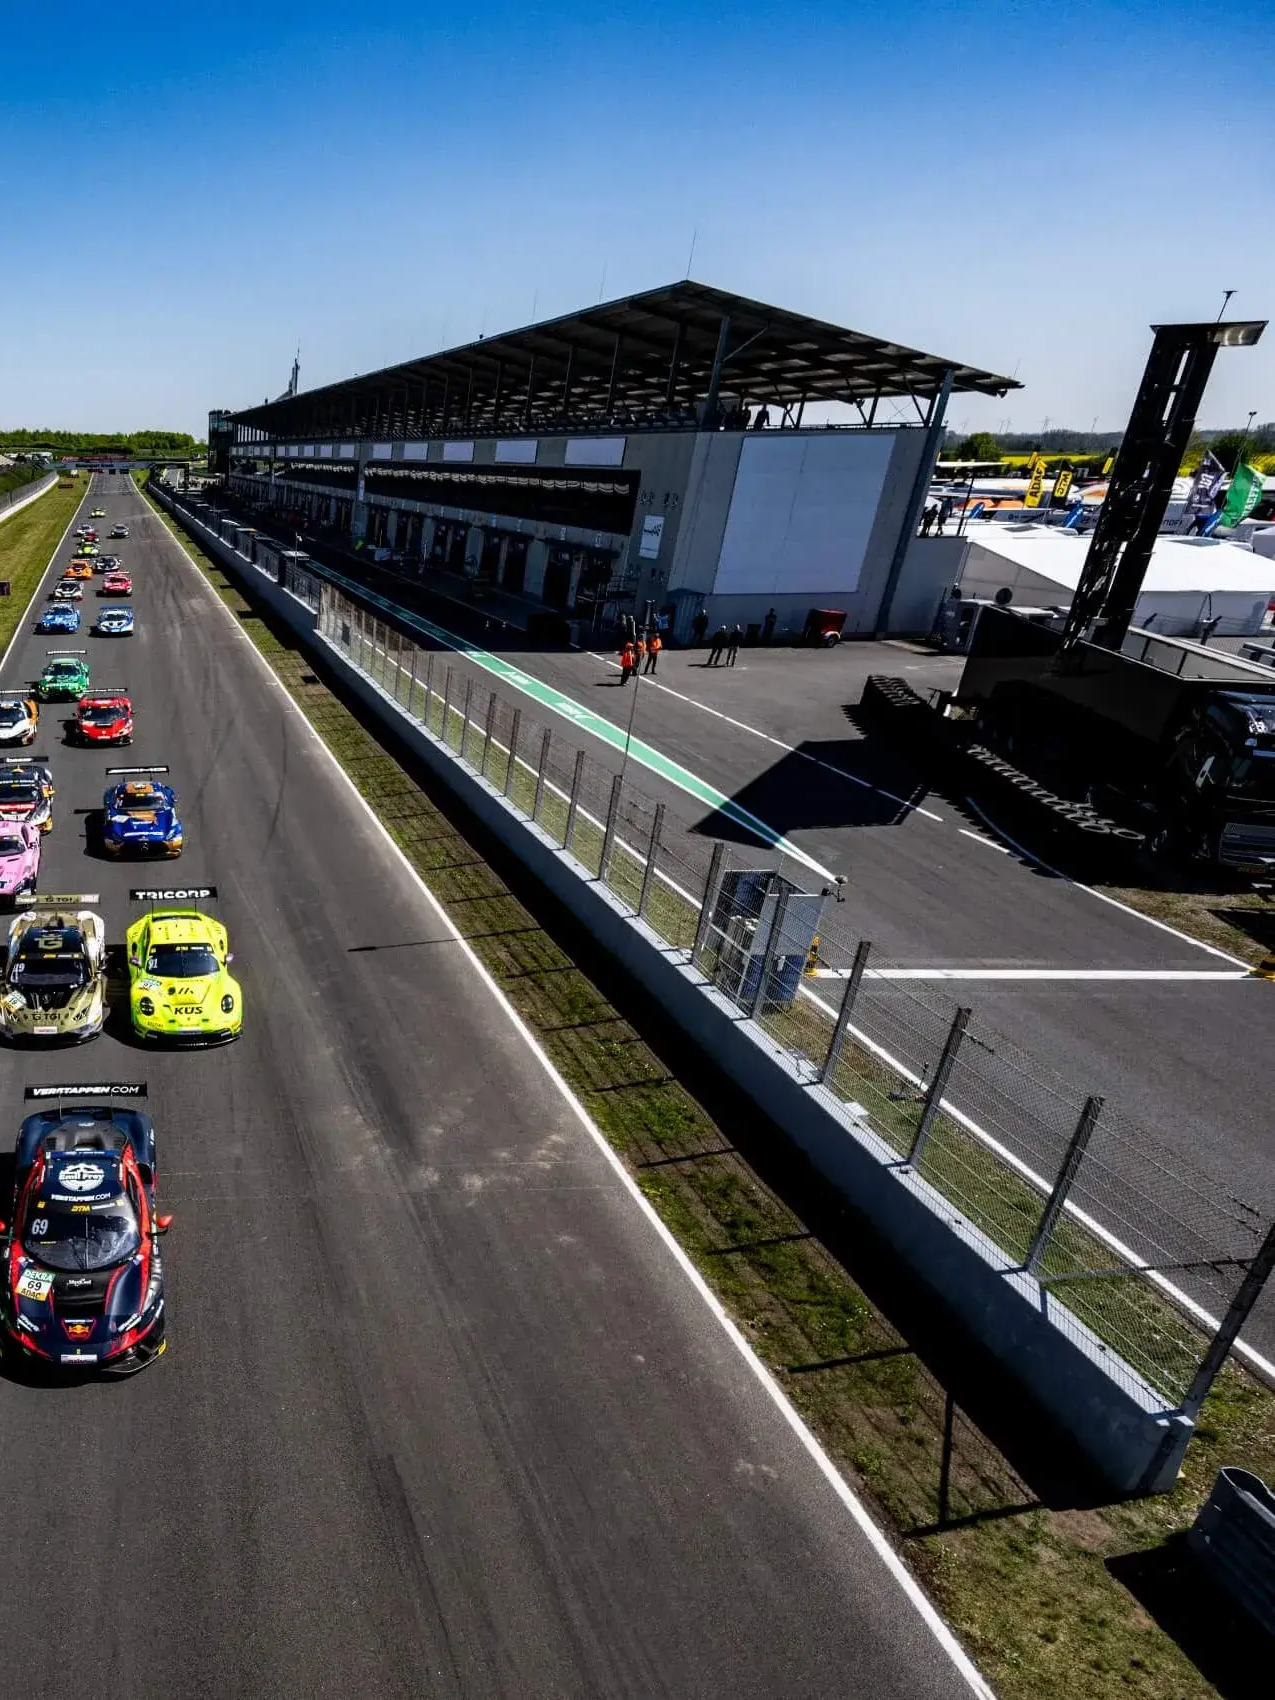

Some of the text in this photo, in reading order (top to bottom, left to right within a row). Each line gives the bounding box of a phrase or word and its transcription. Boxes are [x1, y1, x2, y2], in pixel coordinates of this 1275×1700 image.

[135, 890, 210, 899] TRICORP
[174, 1006, 203, 1015] KÜS
[31, 1219, 49, 1235] 69
[25, 1270, 54, 1283] DEKRA
[27, 1280, 42, 1291] 69
[20, 1288, 42, 1298] ADAC
